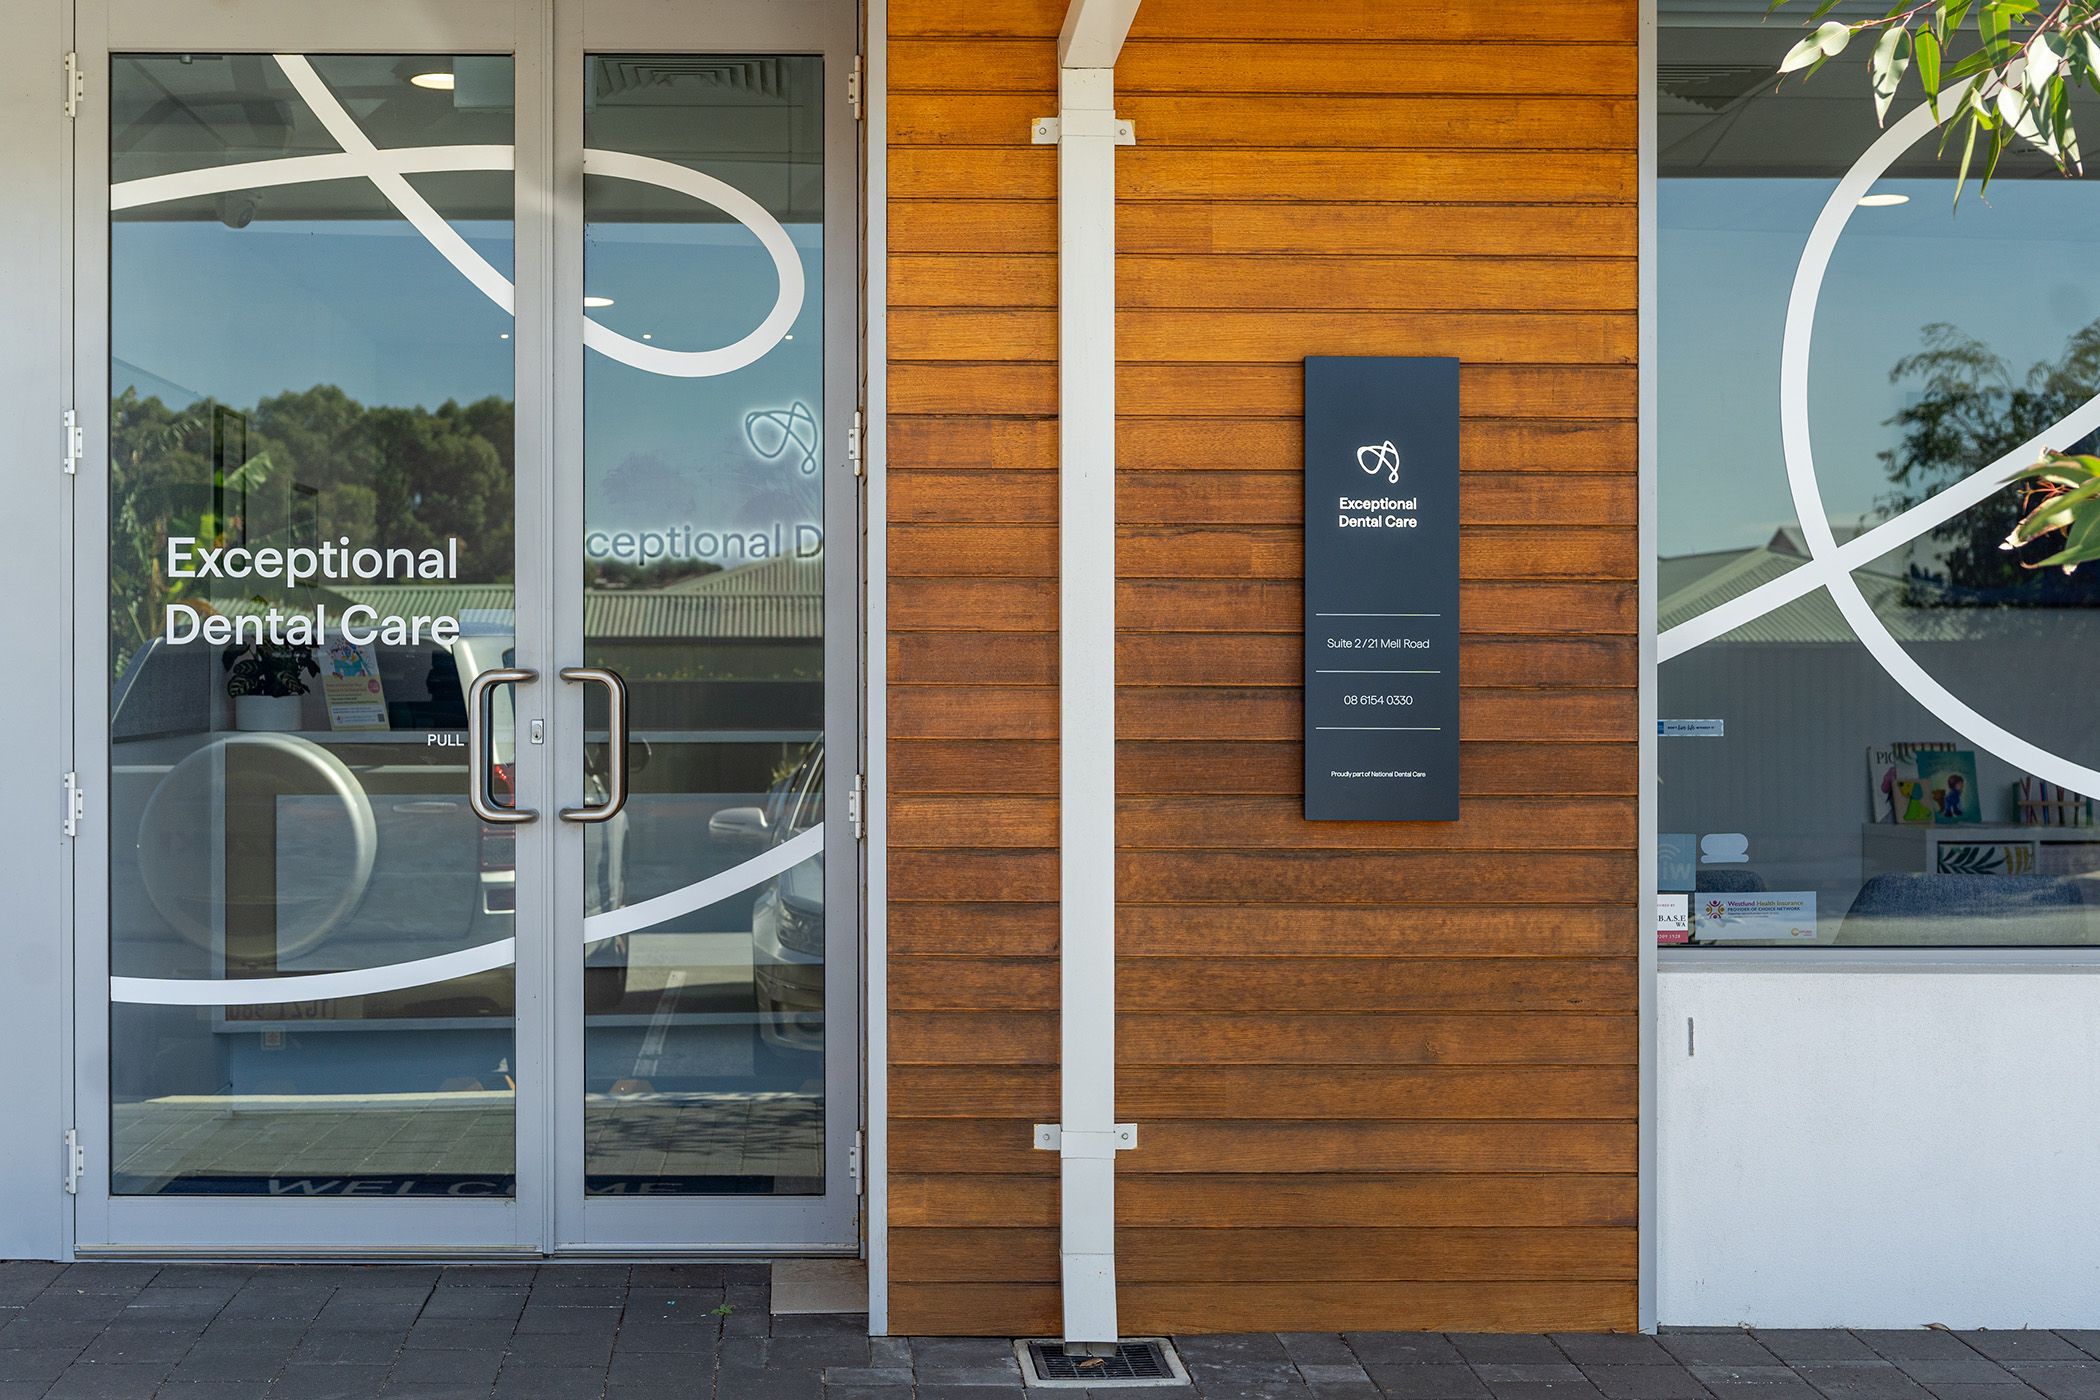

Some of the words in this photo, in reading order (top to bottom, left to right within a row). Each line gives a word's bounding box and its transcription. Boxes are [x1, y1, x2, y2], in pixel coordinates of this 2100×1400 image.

[1339, 497, 1417, 513] Exceptional
[1338, 514, 1382, 528] Dental
[1385, 514, 1418, 528] Care
[167, 536, 457, 588] Exceptional
[166, 603, 325, 647] Dental
[340, 603, 461, 647] Care
[1326, 638, 1353, 649] Suite
[1380, 638, 1401, 649] Mell
[1403, 638, 1430, 649] Road
[1343, 695, 1358, 706] 08
[1360, 695, 1384, 706] 6154
[1386, 695, 1414, 706] 0330
[427, 733, 465, 747] PULL
[1330, 770, 1352, 779] Proudly
[1352, 771, 1364, 779] part
[1364, 770, 1371, 778] of
[1371, 770, 1394, 778] National
[1394, 770, 1412, 778] Dental
[1412, 770, 1427, 778] Care
[268, 1179, 684, 1195] WELCME
